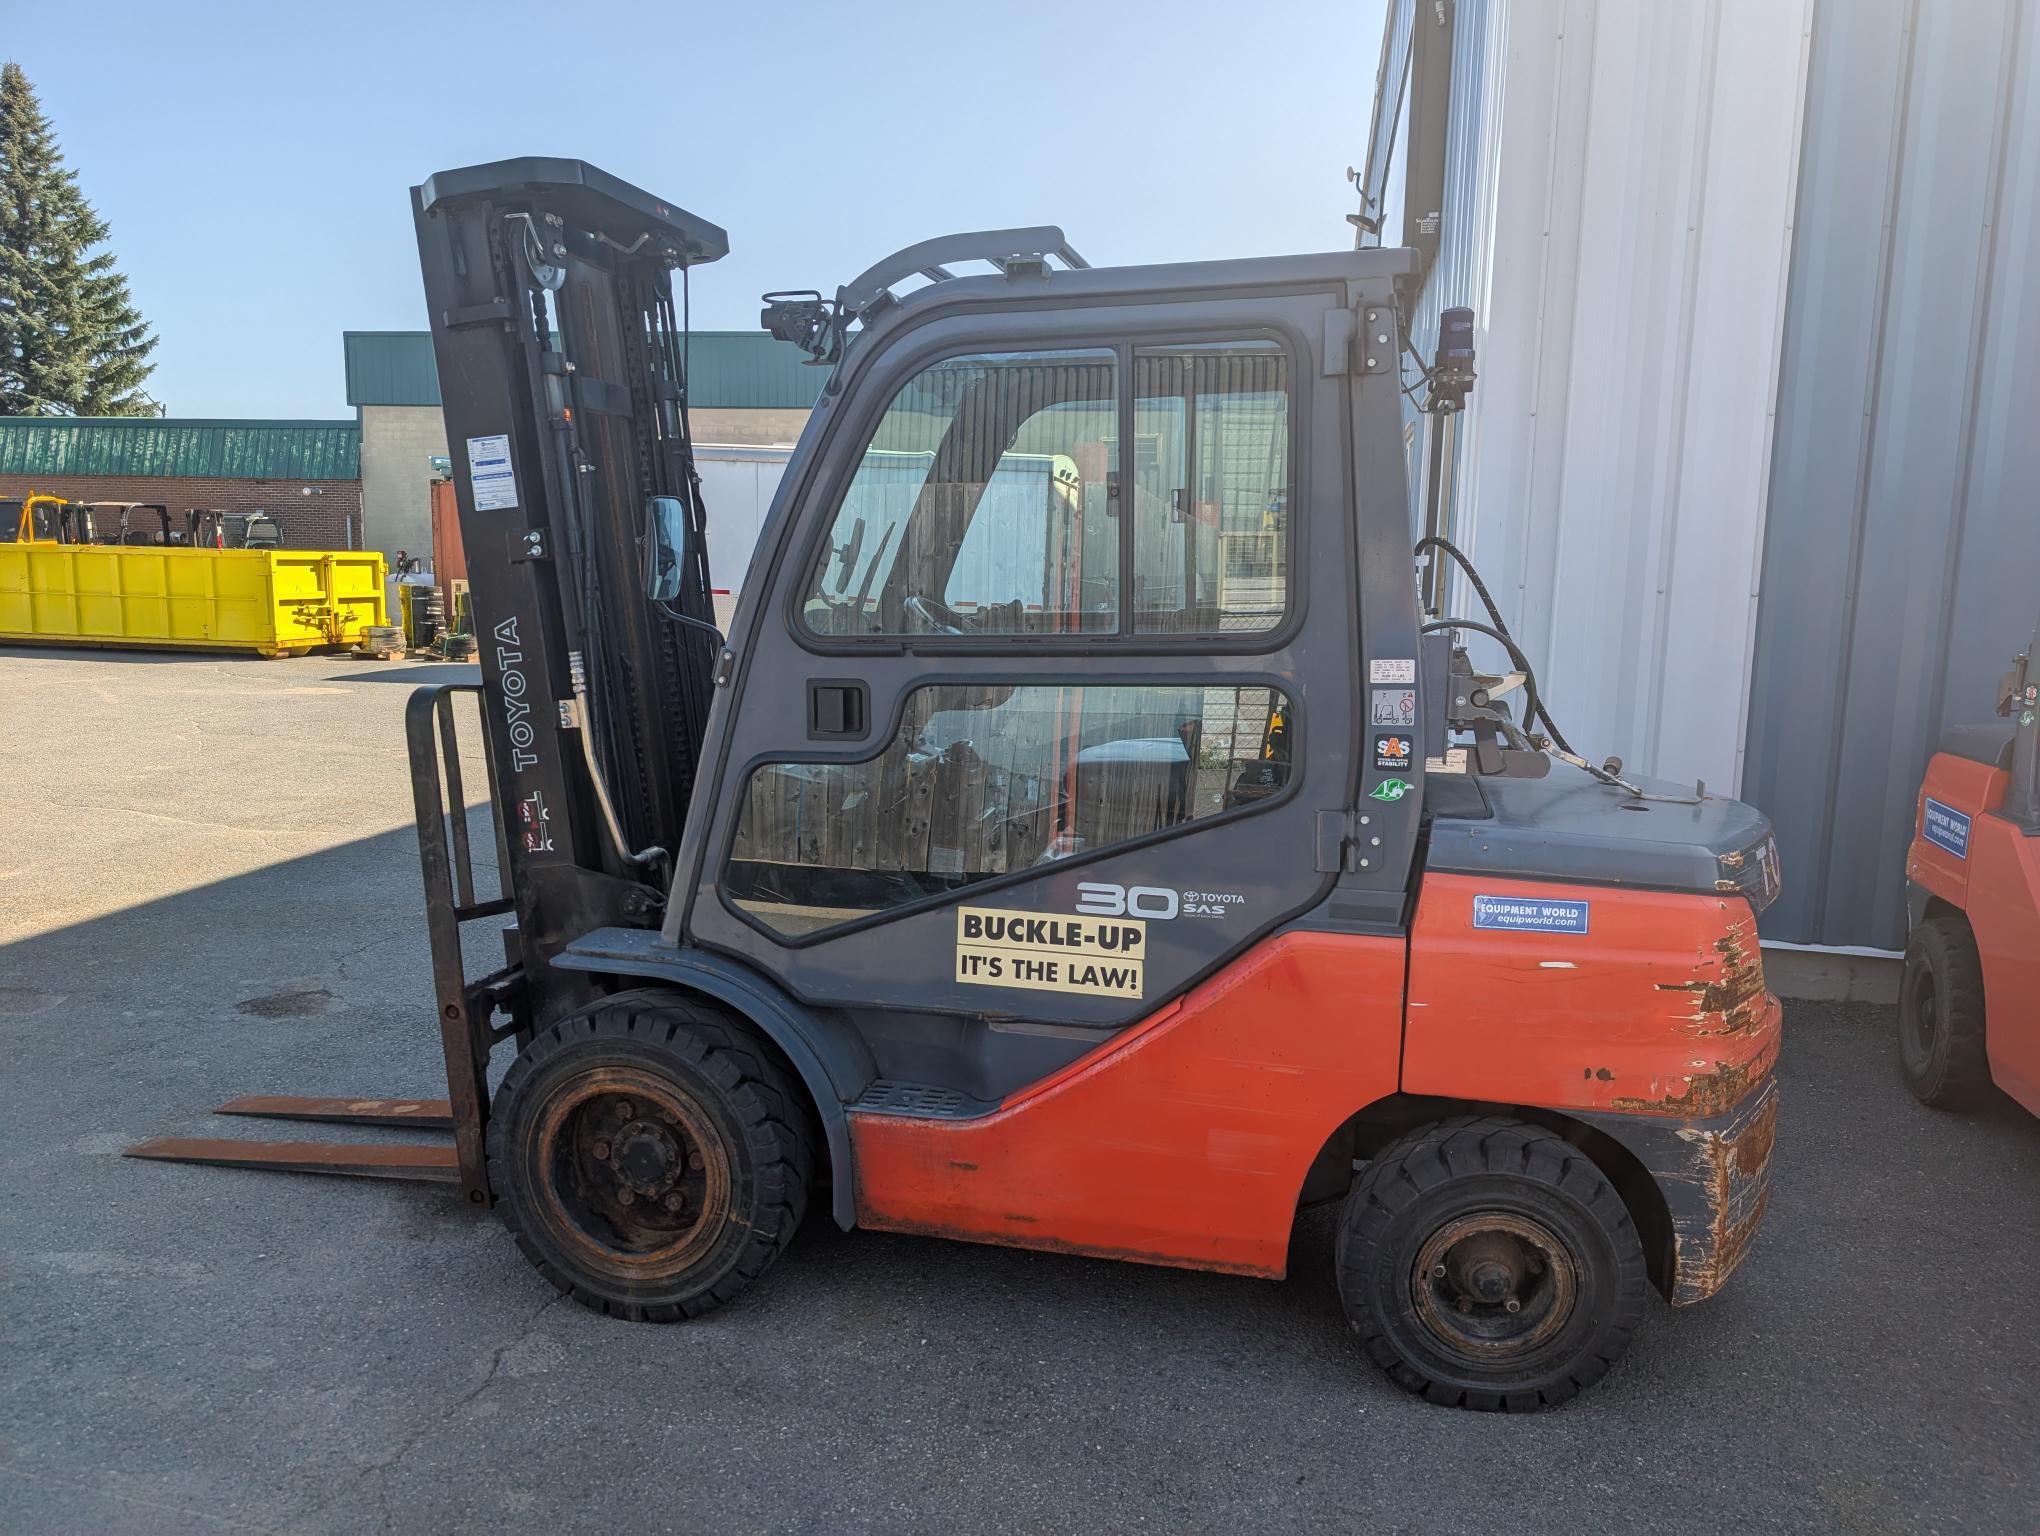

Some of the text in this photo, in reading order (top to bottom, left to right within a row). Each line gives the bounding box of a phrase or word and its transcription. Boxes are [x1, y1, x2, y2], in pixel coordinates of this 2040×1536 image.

[494, 616, 538, 772] TOYOTA
[1377, 738, 1410, 757] SAS
[1075, 882, 1179, 919] 30
[1200, 893, 1246, 904] TOYOTA
[1183, 903, 1226, 914] SAS
[1481, 904, 1579, 918] EQUIPMENT WORLD
[1498, 915, 1577, 927] equipworld.com
[964, 914, 1142, 952] BUCKLE-UP
[961, 955, 1137, 990] IT'S THE LAW!
